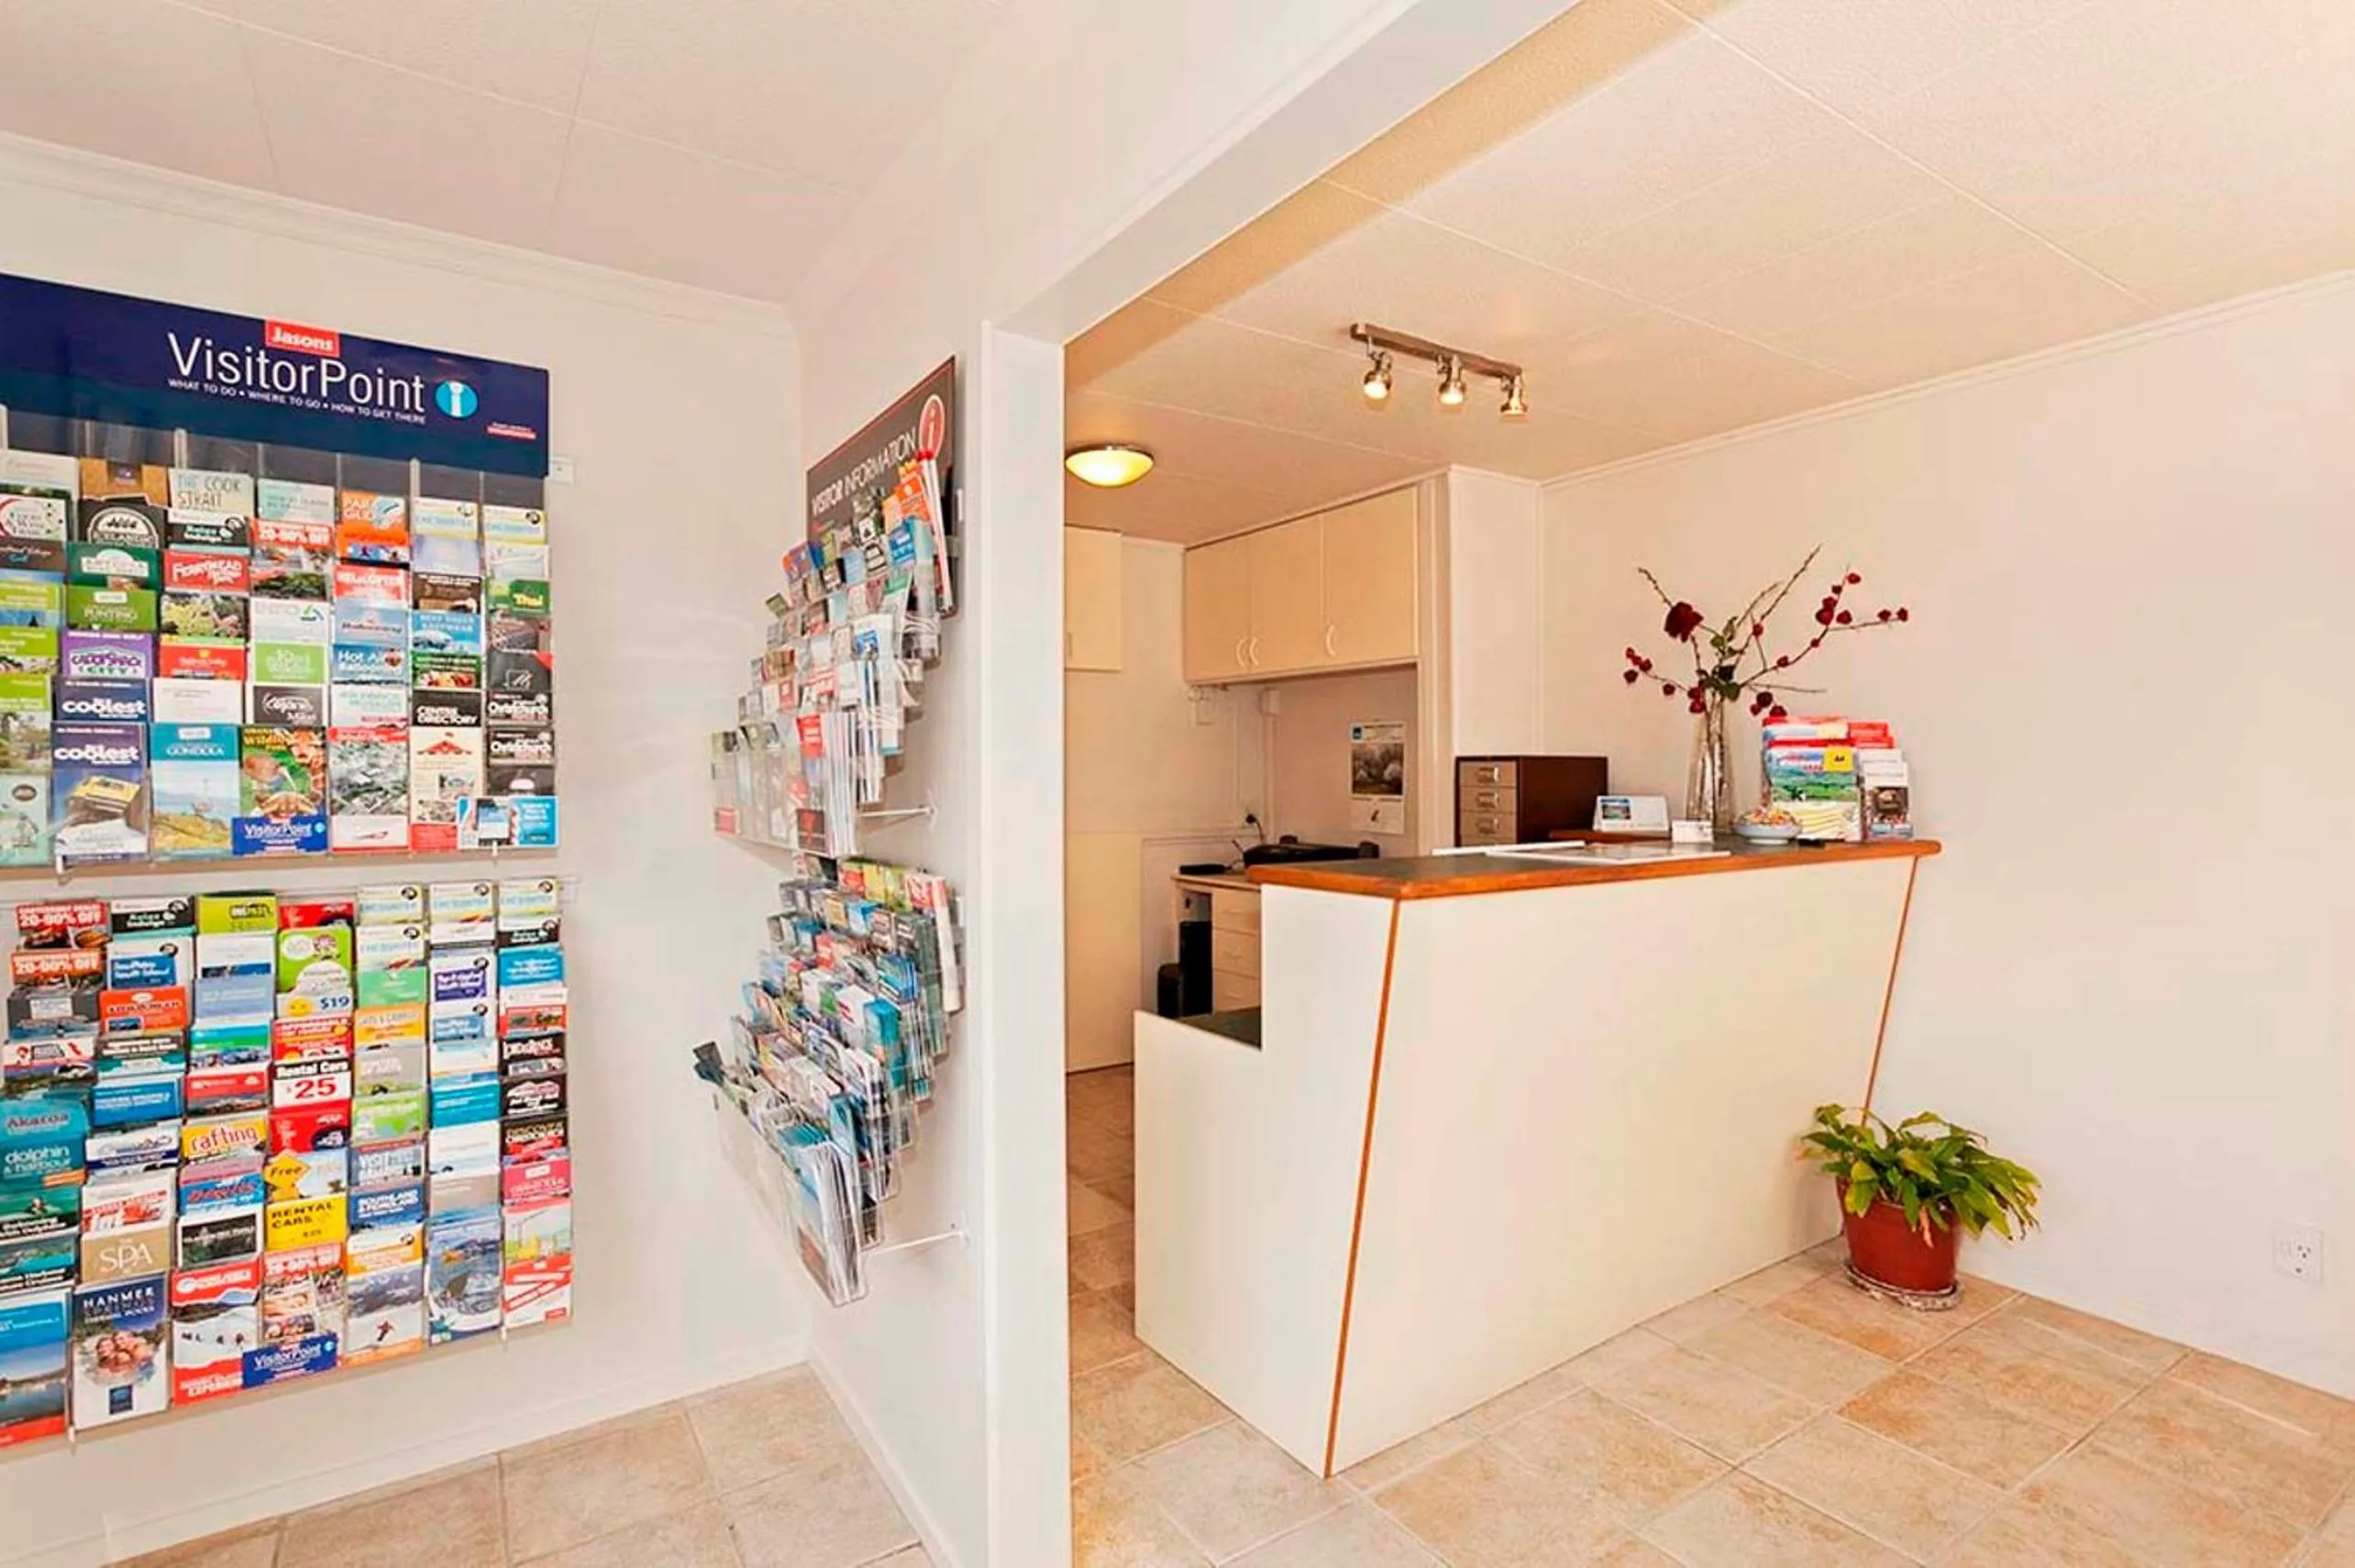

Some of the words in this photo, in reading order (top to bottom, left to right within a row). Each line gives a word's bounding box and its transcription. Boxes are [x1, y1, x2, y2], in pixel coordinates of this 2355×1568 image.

[272, 326, 334, 352] Jasons
[168, 331, 426, 413] VisitorPoint
[168, 378, 200, 392] WHAT
[203, 382, 218, 395] TO
[220, 385, 238, 397] DO
[247, 390, 287, 405] WHERE
[290, 395, 304, 407] TO
[304, 398, 322, 410] GO
[330, 402, 357, 414] HOW
[357, 404, 371, 417] TO
[372, 407, 393, 419] GET
[395, 410, 426, 425] THERE
[811, 479, 844, 516] VISITOR
[844, 425, 917, 497] INFORMATION
[204, 475, 243, 493] COOK
[177, 491, 224, 508] STRAIT
[337, 649, 364, 664] Hot
[61, 697, 148, 715] coolest
[53, 744, 140, 761] coolest
[165, 747, 226, 757] GONDOLA
[320, 995, 350, 1010] $19
[277, 1063, 317, 1077] Rental
[320, 1059, 349, 1074] Cars
[6, 1111, 71, 1129] Akaroa
[191, 1124, 258, 1152] rafting
[5, 1145, 71, 1165] dolphin
[15, 1159, 72, 1174] harbour
[269, 1165, 303, 1177] Free
[271, 1201, 335, 1220] RENTAL
[271, 1216, 314, 1230] CARS
[100, 1242, 154, 1274] SPA
[83, 1286, 155, 1309] HANMER
